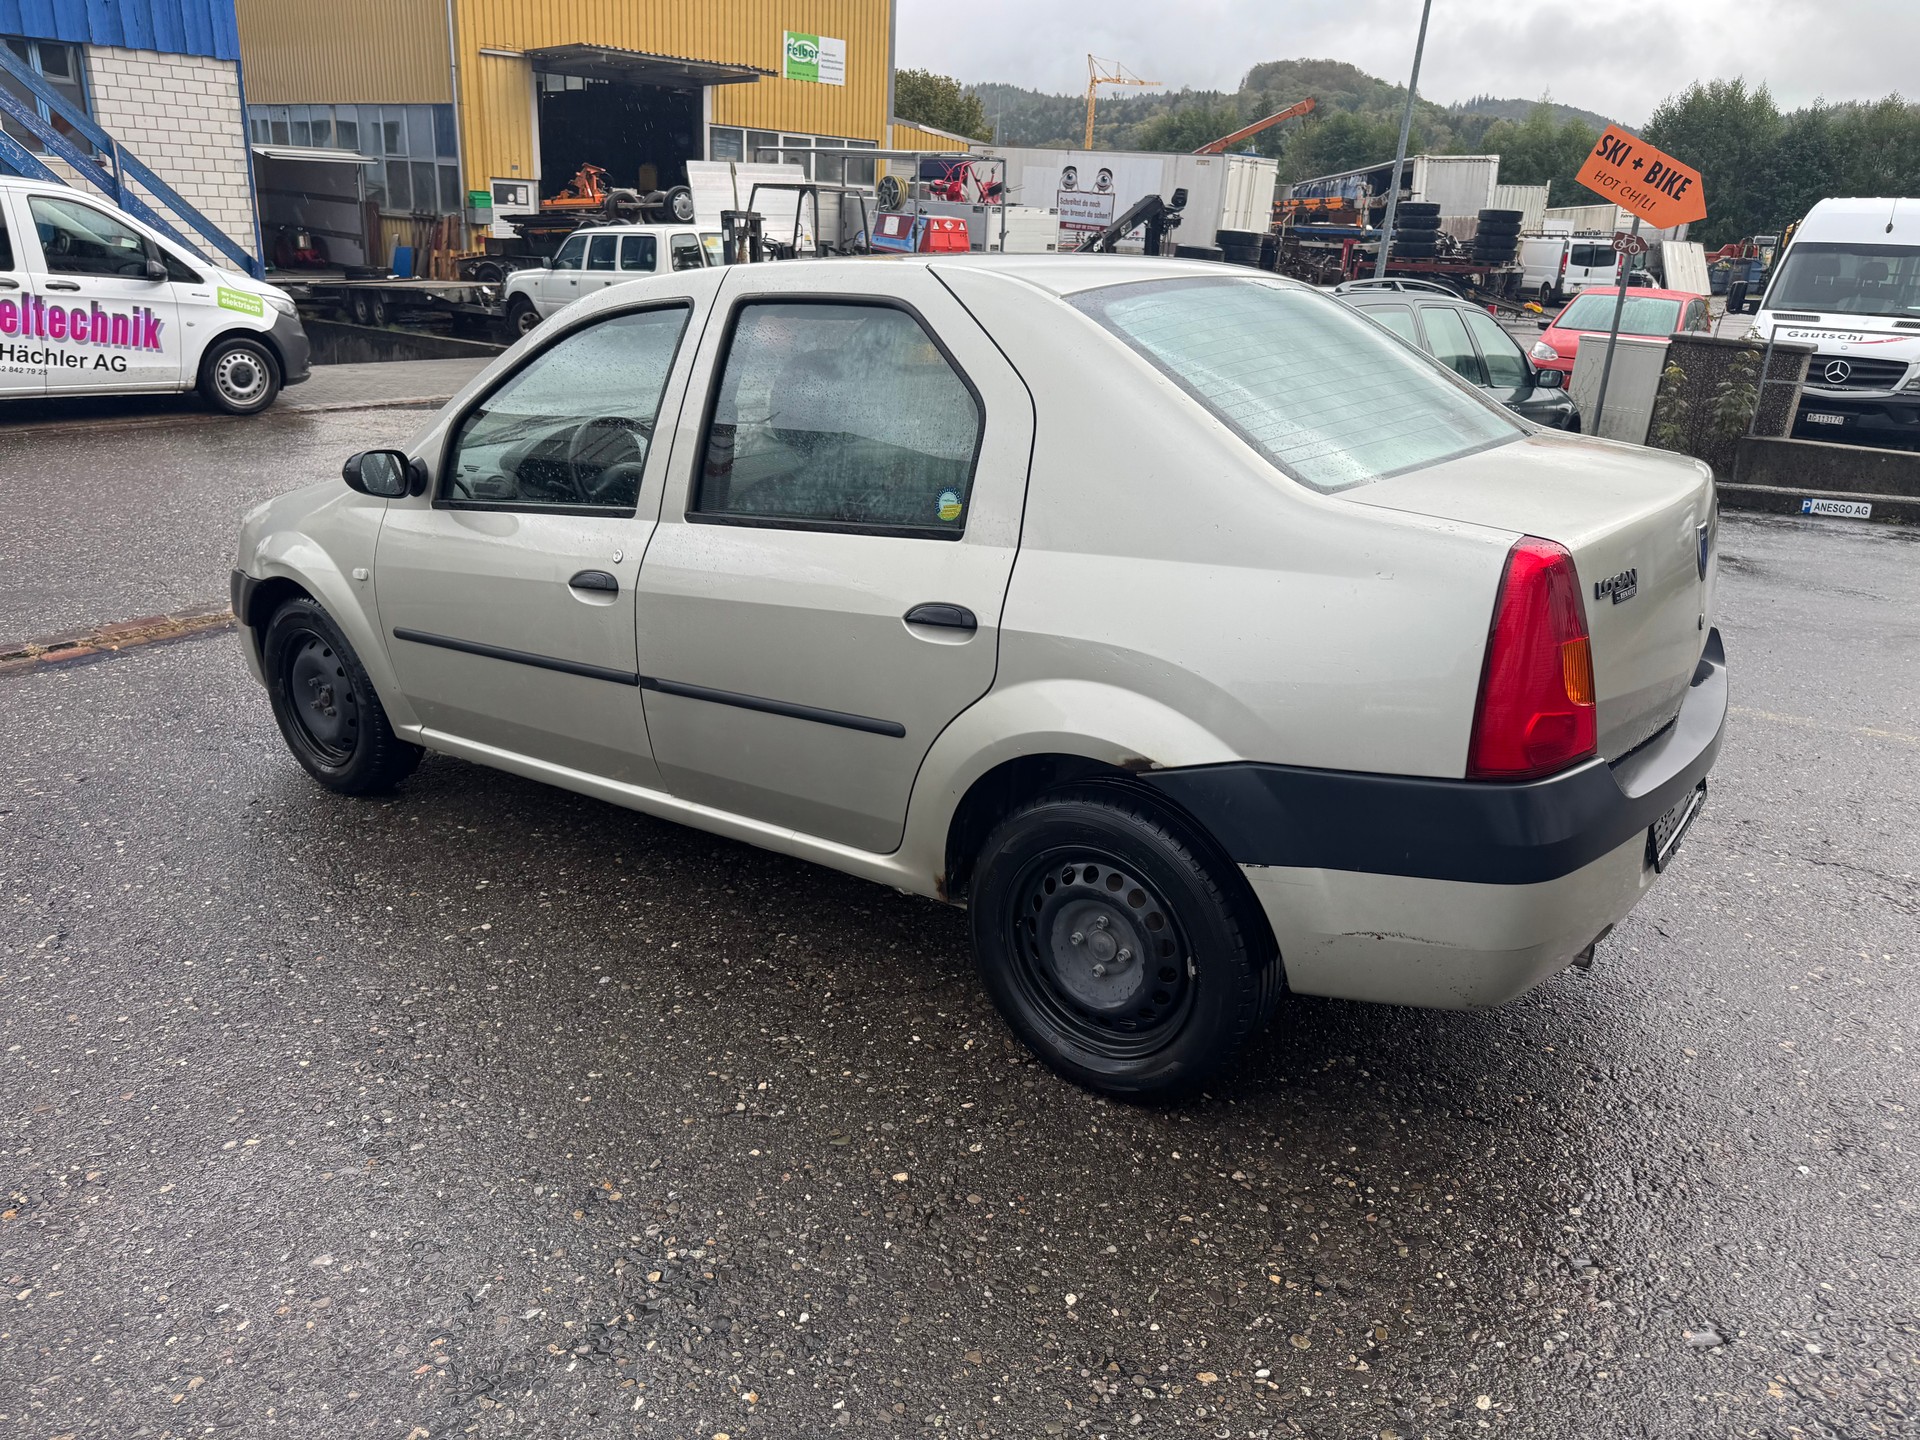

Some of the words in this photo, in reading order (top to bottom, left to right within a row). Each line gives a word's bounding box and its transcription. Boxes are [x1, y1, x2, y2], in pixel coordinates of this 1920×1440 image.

[1596, 134, 1632, 167] SKI
[1632, 157, 1644, 170] +
[1643, 160, 1692, 201] BIKE
[1594, 170, 1621, 190] HOT
[1620, 186, 1656, 211] CHILI
[221, 297, 260, 313] elektrisch
[1787, 330, 1864, 341] Gautschi
[0, 344, 88, 368] Hächler
[93, 354, 127, 372] AG
[9, 366, 23, 374] 842
[1813, 502, 1853, 514] ANESGO
[1854, 505, 1869, 516] AG
[1595, 568, 1637, 600] LOGAN
